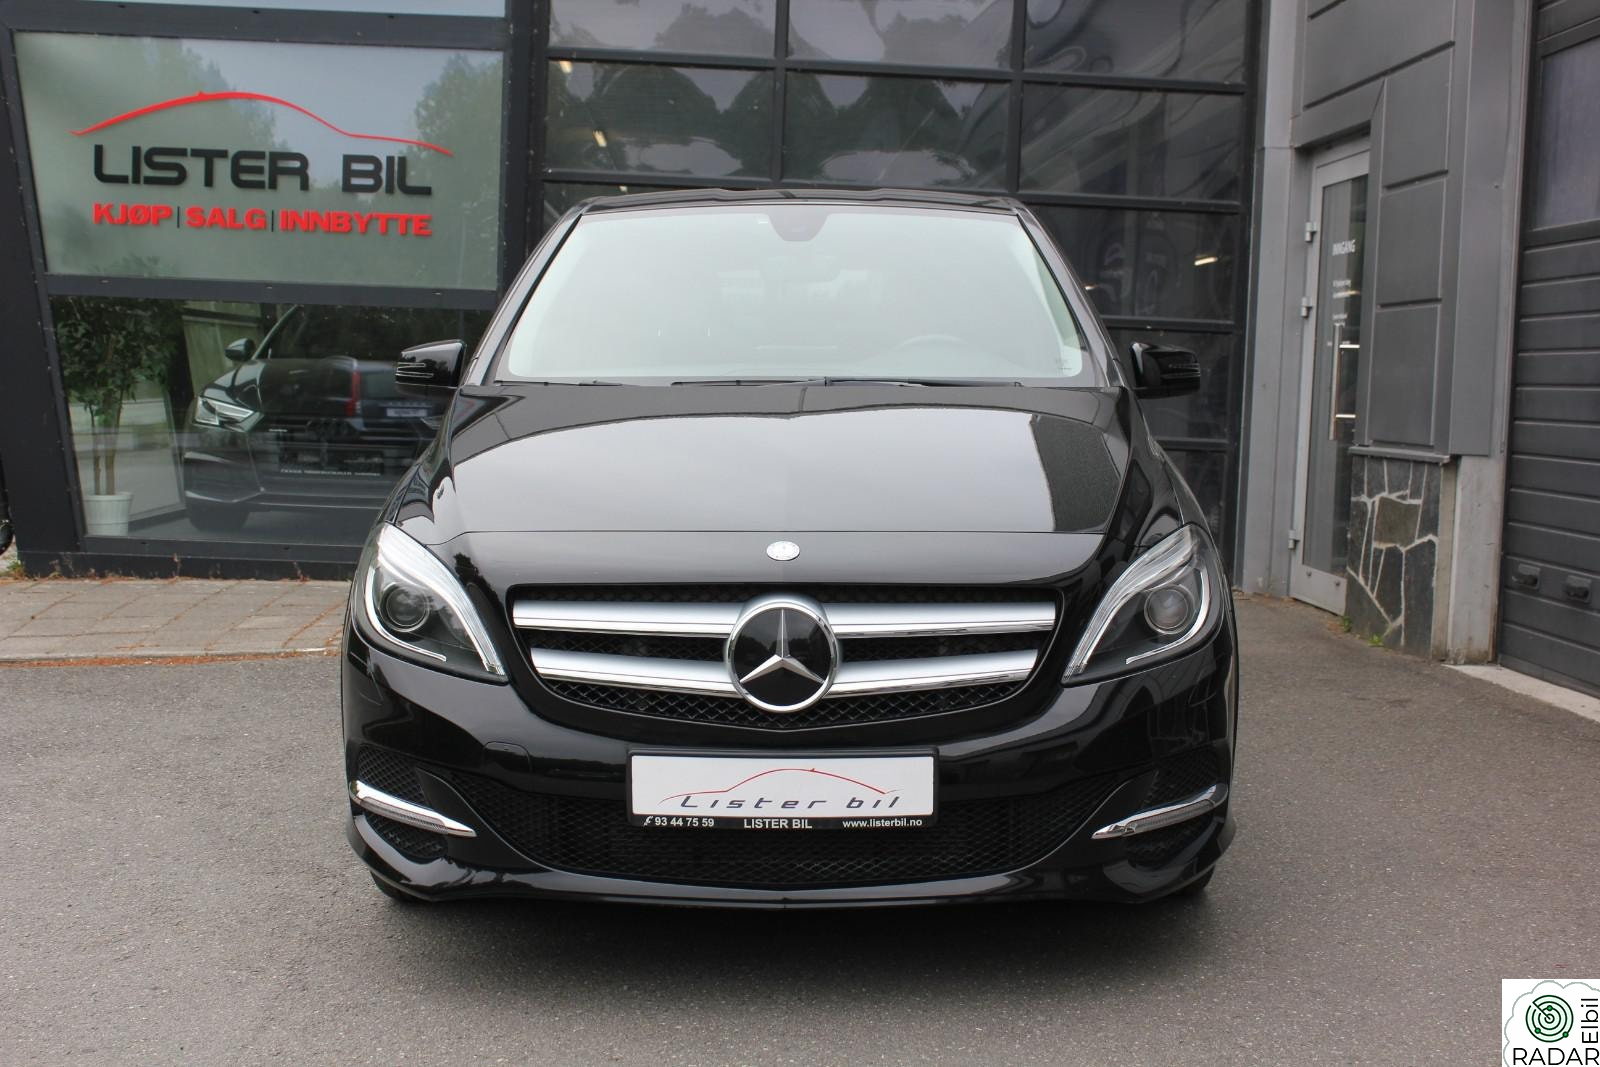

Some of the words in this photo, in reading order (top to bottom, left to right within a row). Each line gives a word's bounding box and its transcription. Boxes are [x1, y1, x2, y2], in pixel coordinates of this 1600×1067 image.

[93, 144, 310, 192] LISTER
[341, 154, 433, 196] BIL
[93, 203, 172, 226] KJØP
[186, 207, 267, 230] SALG
[279, 209, 433, 236] INNBYTTE
[680, 795, 827, 809] Lister
[846, 796, 900, 809] bil
[654, 816, 668, 827] 93
[670, 817, 684, 827] 44
[685, 817, 699, 827] 75
[701, 818, 715, 828] 59
[743, 818, 789, 829] LISTER
[792, 818, 813, 829] BIL
[842, 817, 923, 828] www.listerbil.no
